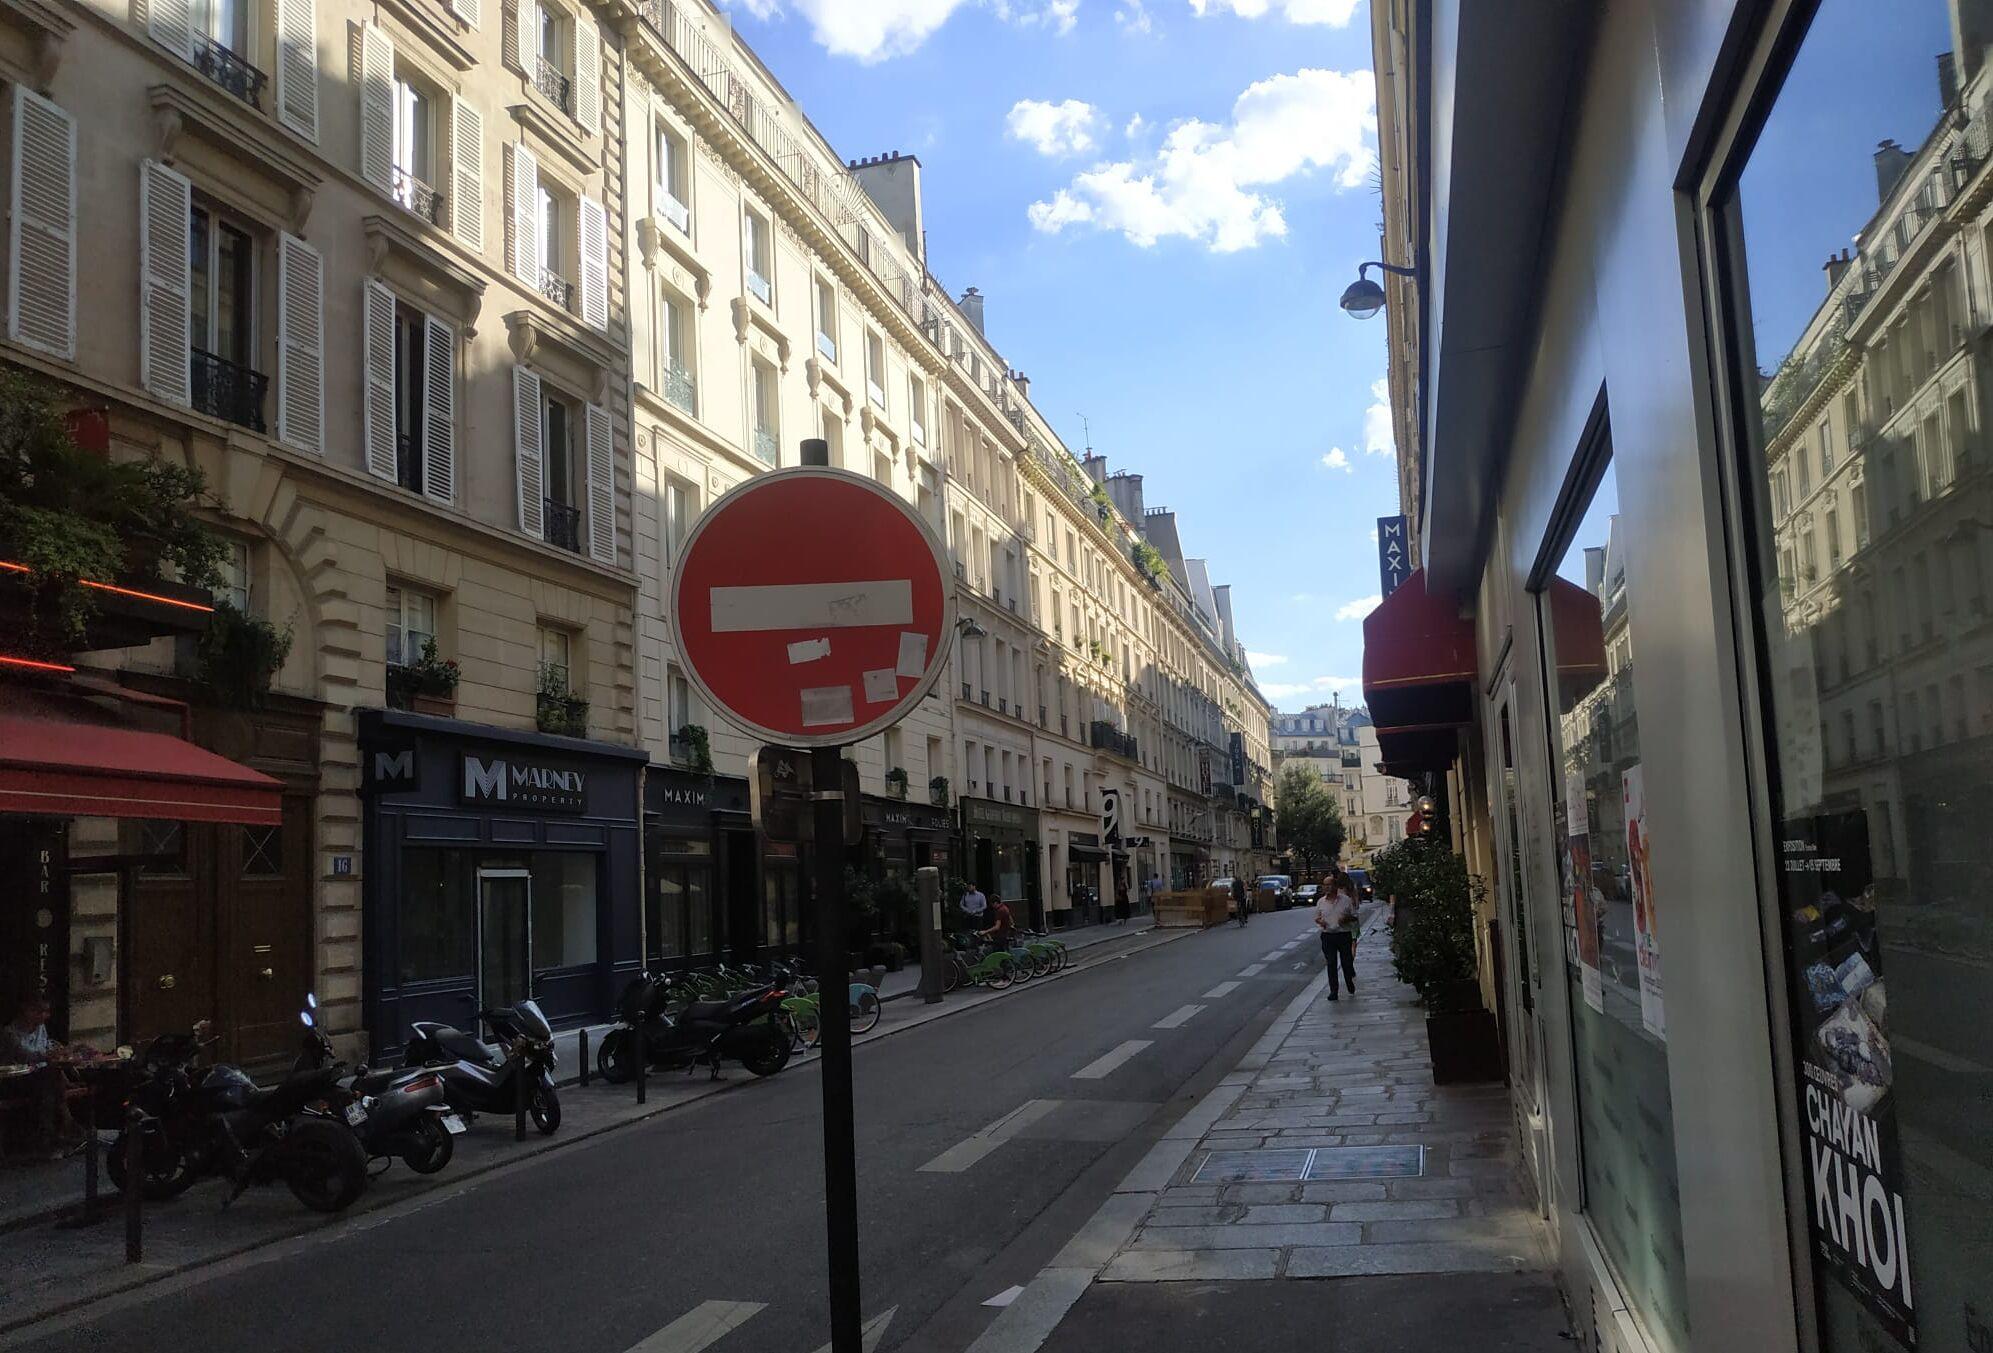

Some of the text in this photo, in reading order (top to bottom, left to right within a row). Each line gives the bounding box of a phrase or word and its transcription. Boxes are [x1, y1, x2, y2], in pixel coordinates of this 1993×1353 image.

[1384, 523, 1402, 596] MAXI
[375, 750, 414, 781] M
[464, 756, 585, 801] M MARNEY
[512, 792, 583, 807] PROPERTY
[664, 788, 705, 807] MAXIM
[886, 813, 907, 826] MAXIM
[40, 849, 51, 894] BAR
[338, 859, 349, 873] 16
[1806, 1083, 1882, 1174] CHAYAN
[1810, 1137, 1914, 1308] KHOI
